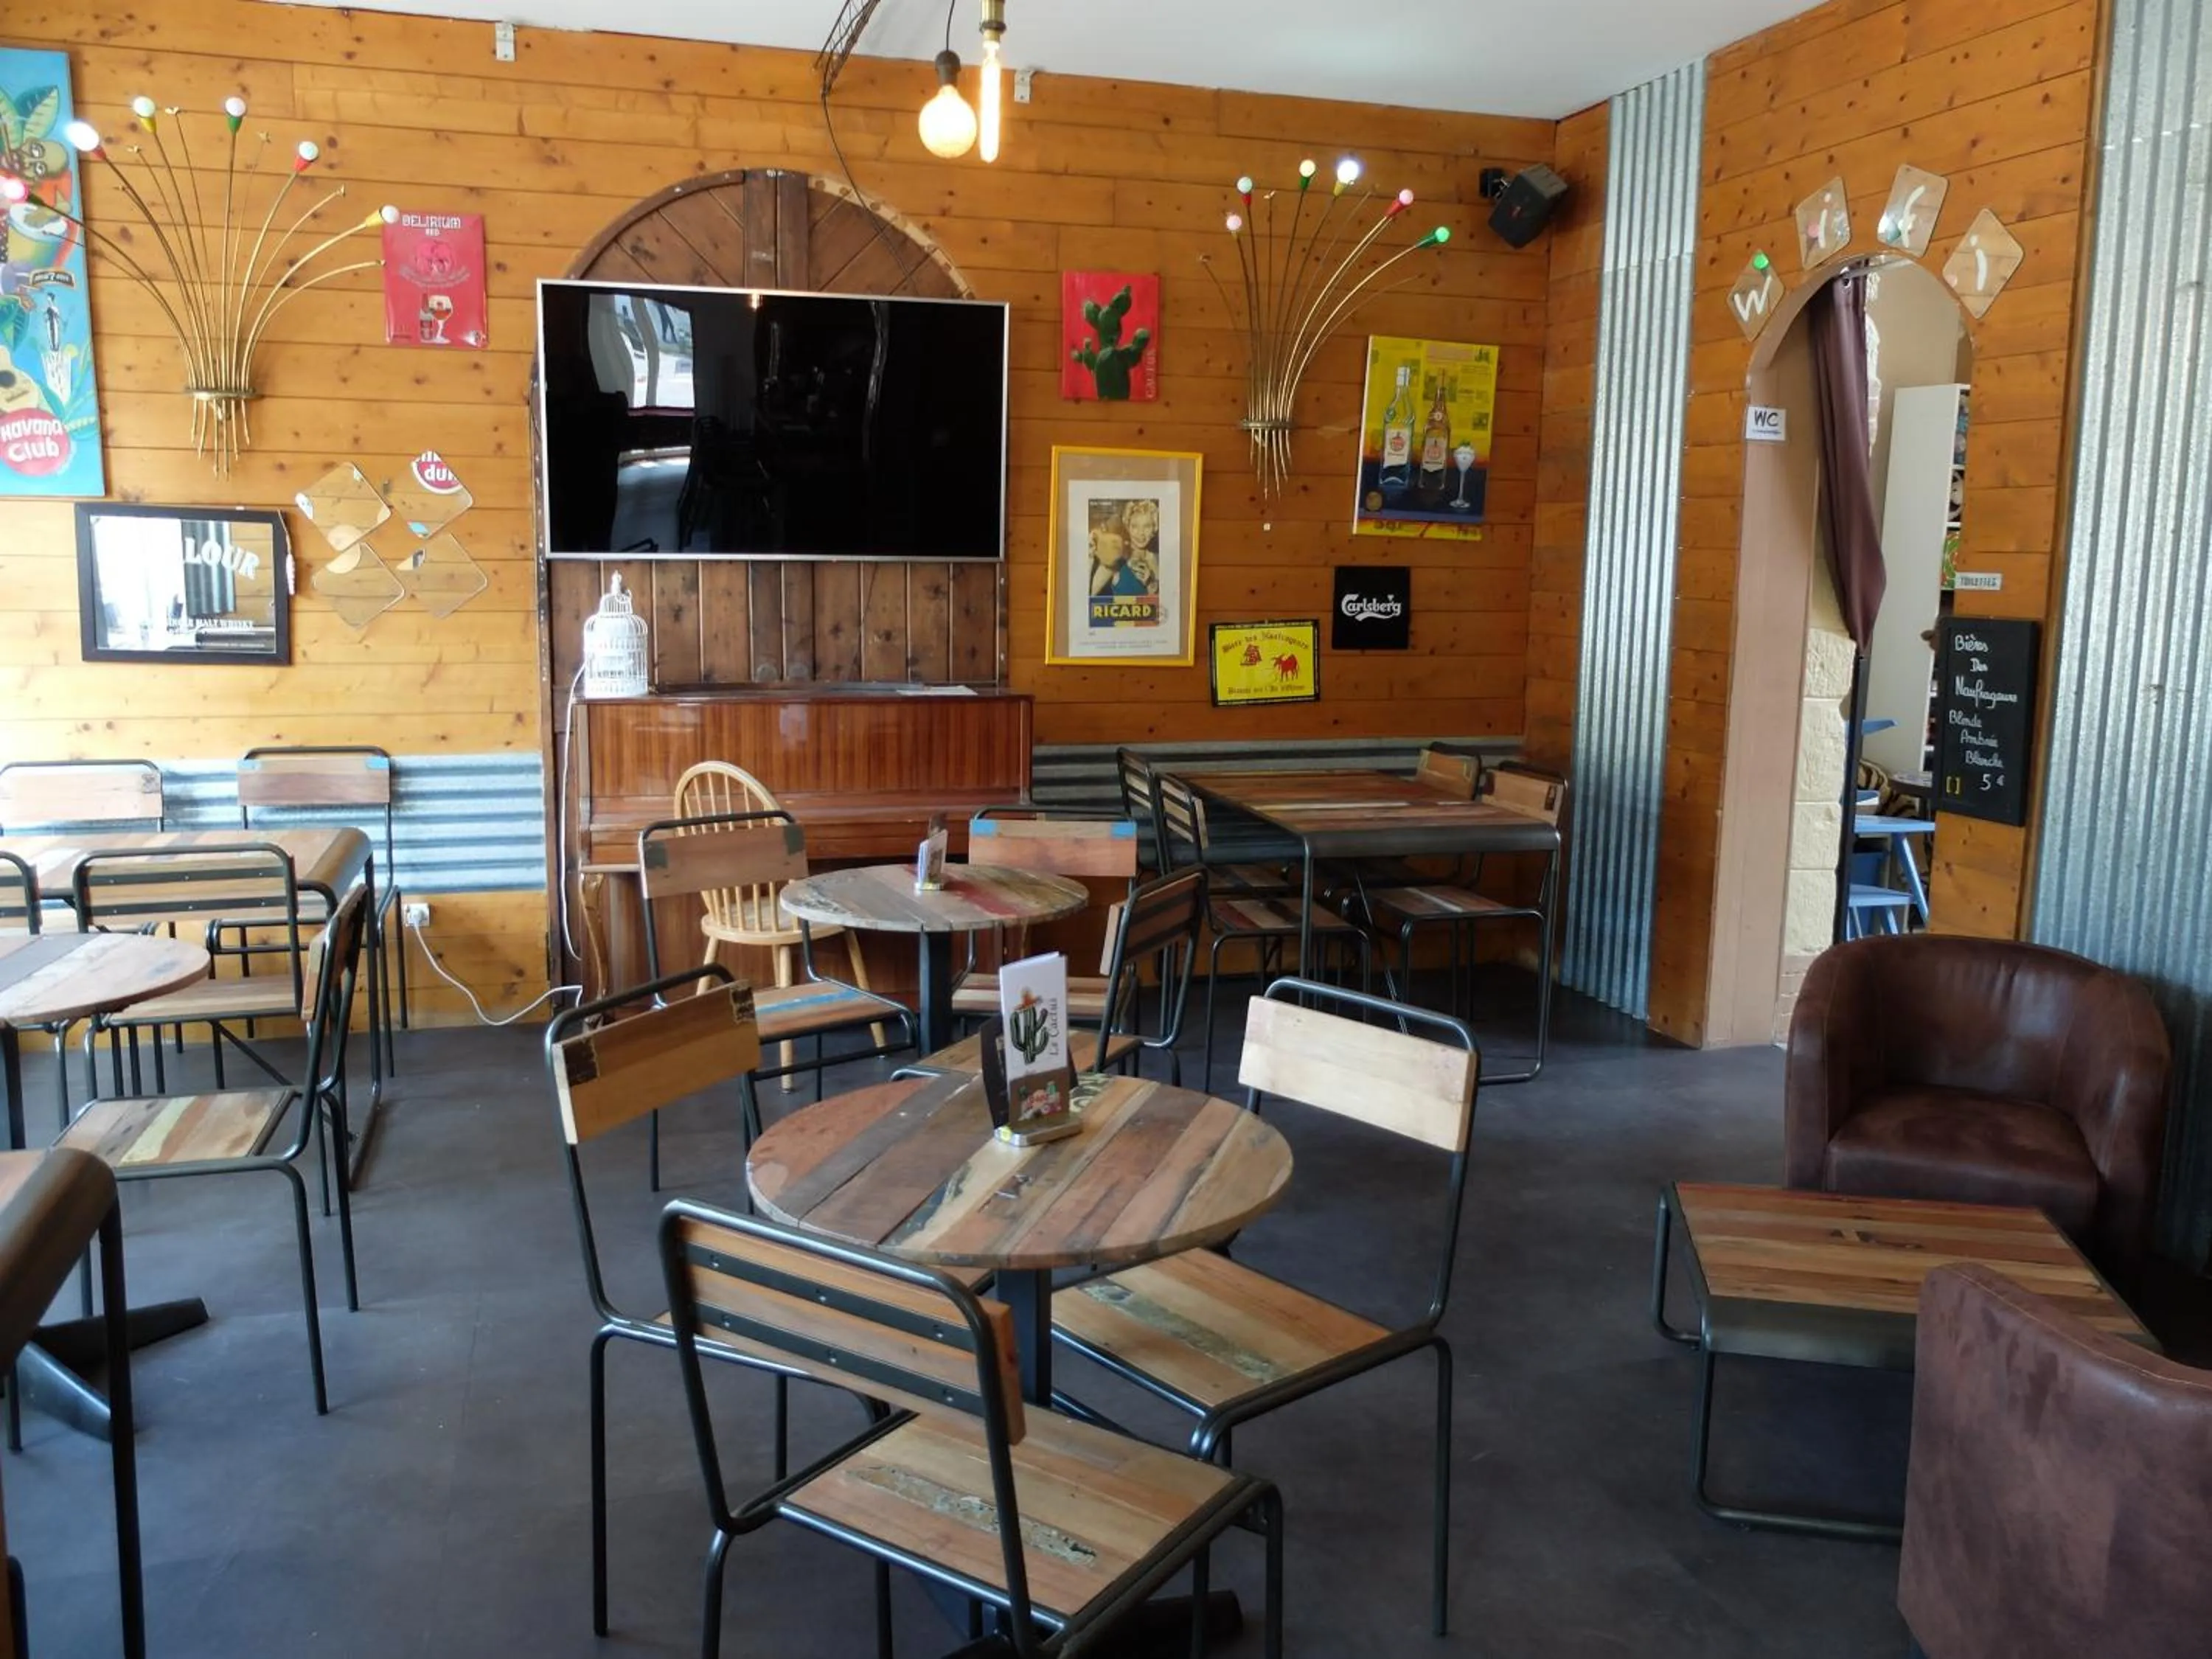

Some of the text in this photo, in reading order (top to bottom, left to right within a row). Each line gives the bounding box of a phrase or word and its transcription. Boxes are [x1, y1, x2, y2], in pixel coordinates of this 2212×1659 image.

[401, 214, 461, 229] DELIRIUM
[1754, 410, 1779, 427] WC
[8, 436, 60, 462] Club
[1093, 605, 1152, 618] RICARD
[1341, 594, 1402, 621] Carlsberg
